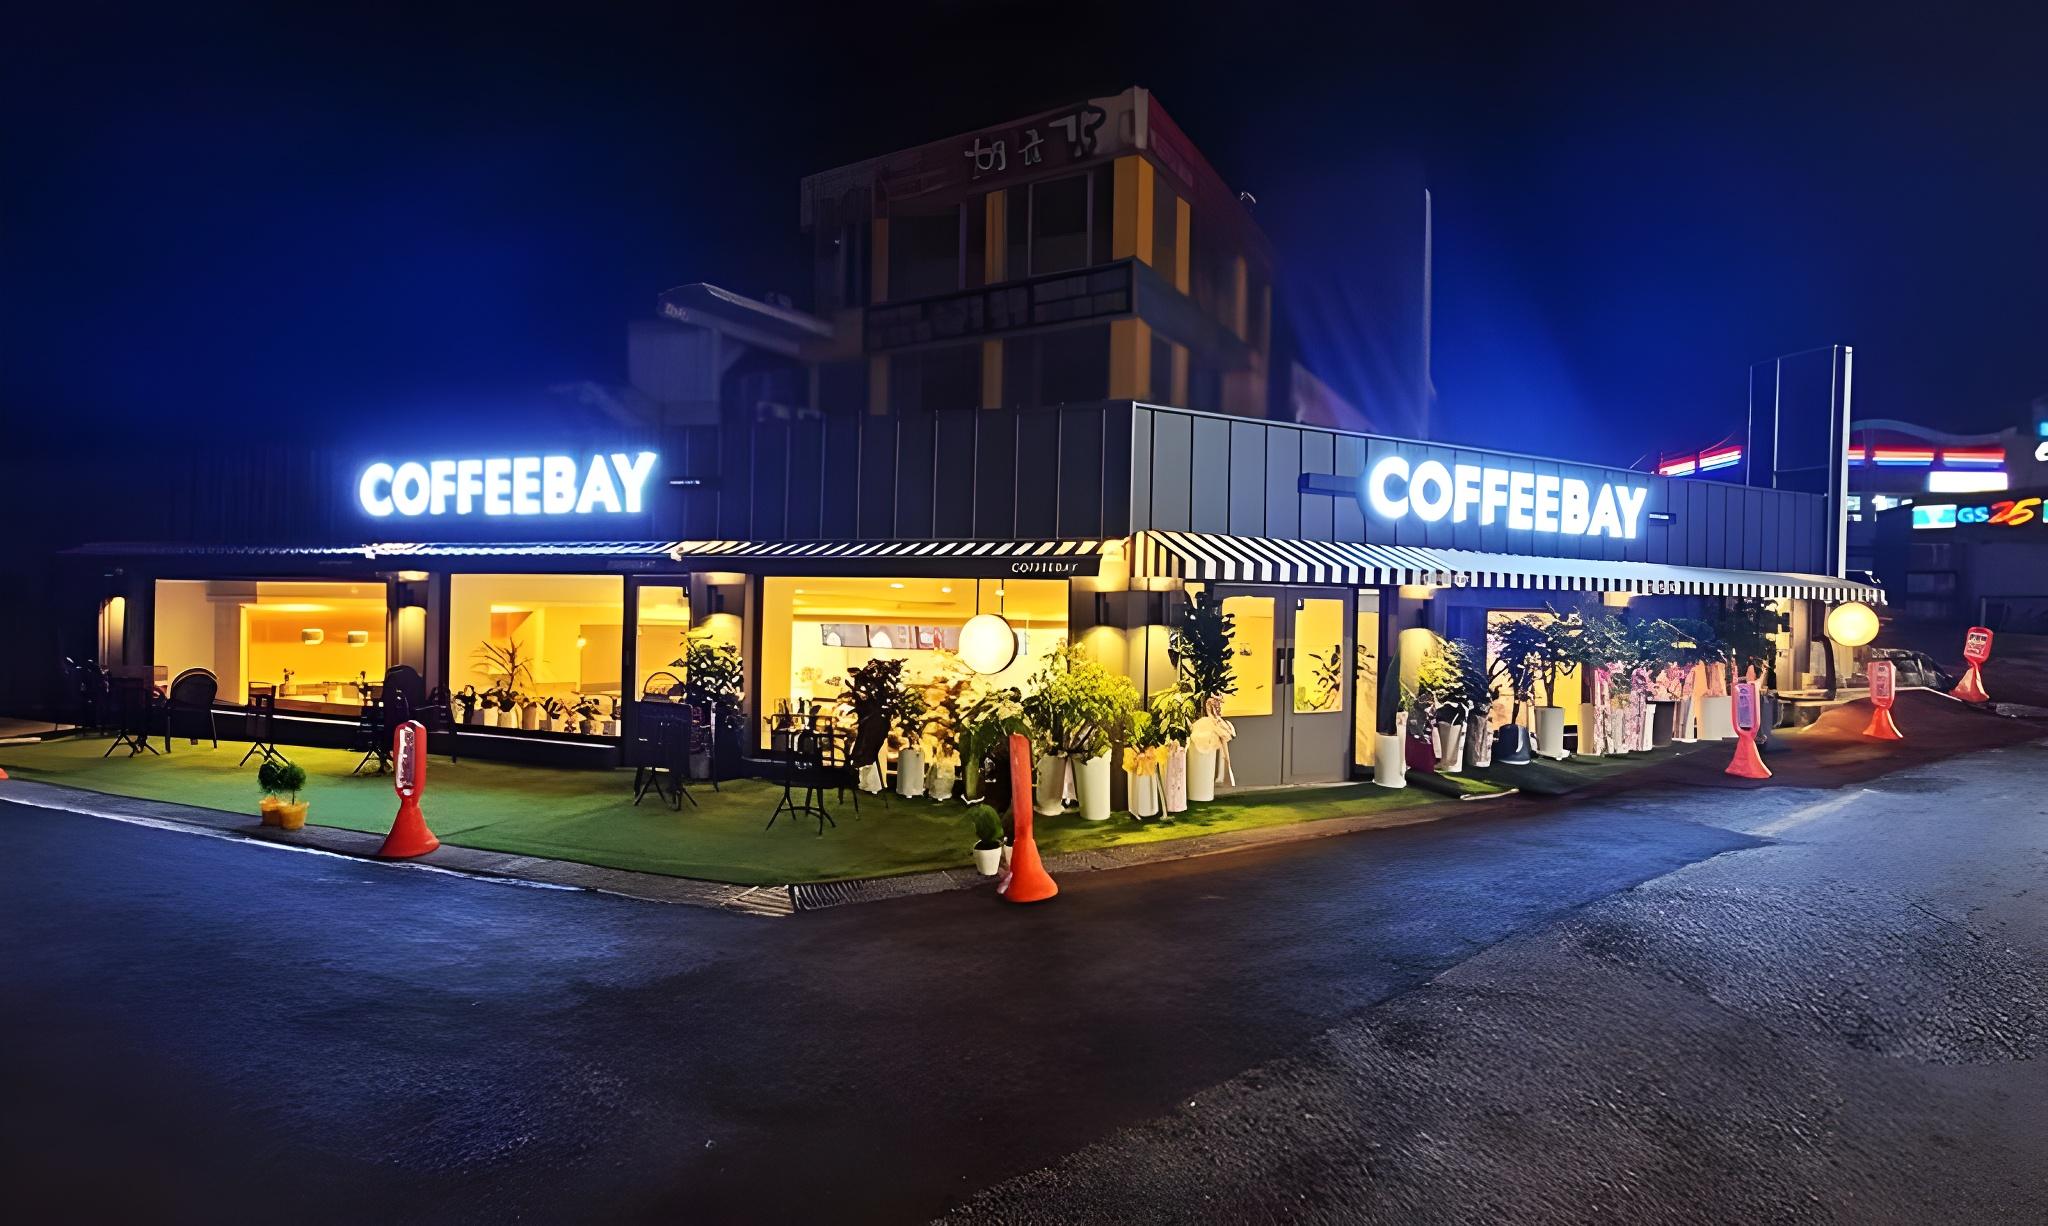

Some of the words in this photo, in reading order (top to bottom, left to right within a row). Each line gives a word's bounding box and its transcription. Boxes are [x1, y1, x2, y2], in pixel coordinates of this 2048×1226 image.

[359, 452, 657, 516] COFFEEBAY
[1368, 456, 1647, 539] COFFEEBAY
[1957, 498, 2041, 525] GS25
